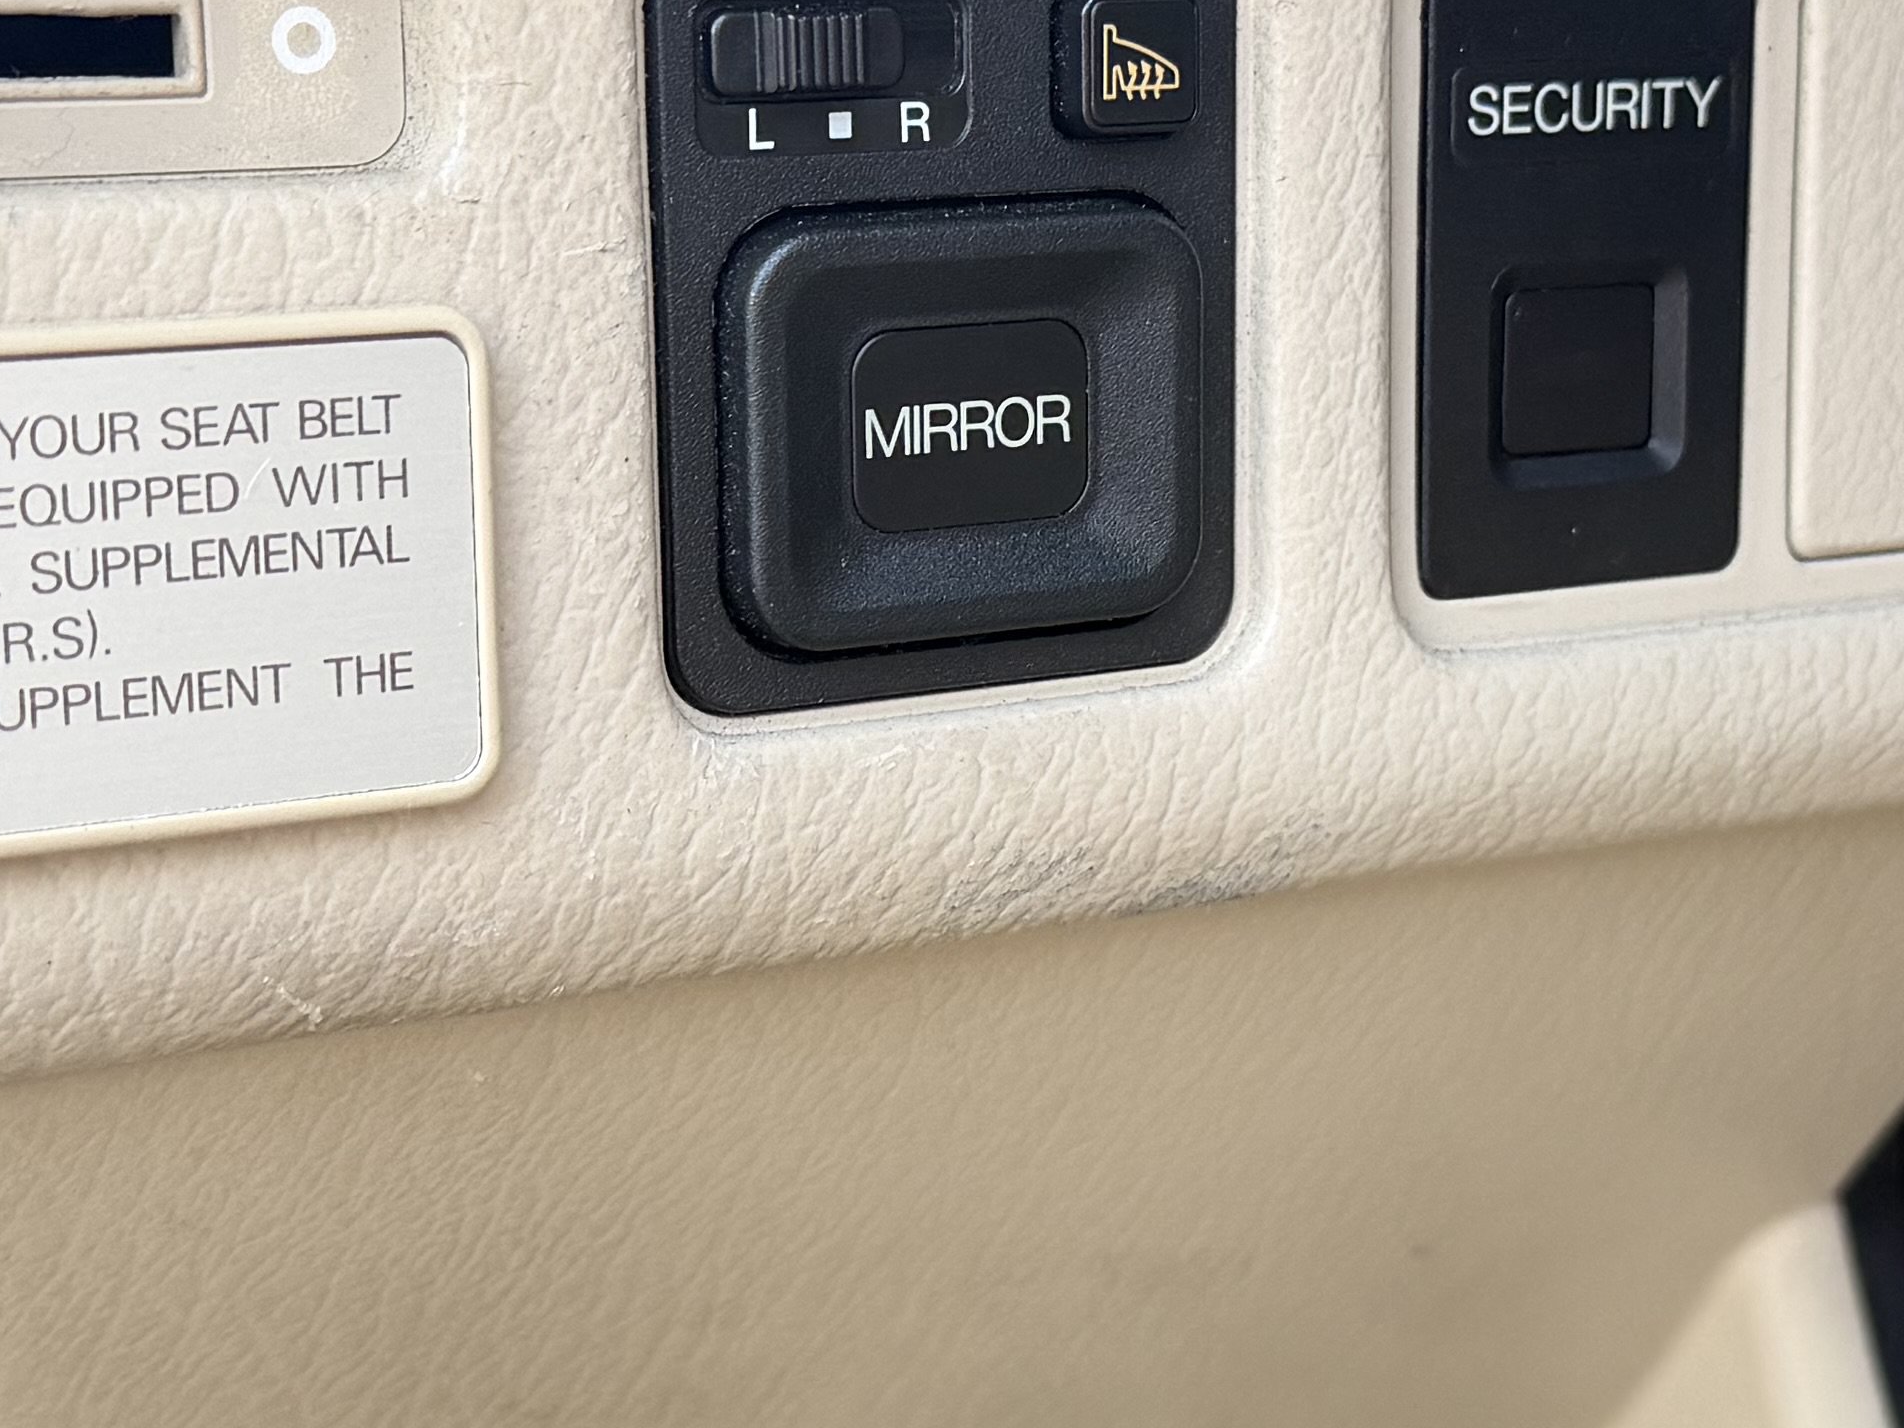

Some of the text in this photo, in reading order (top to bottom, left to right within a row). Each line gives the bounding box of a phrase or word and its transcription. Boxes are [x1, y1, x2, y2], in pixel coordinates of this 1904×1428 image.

[749, 108, 774, 150] L
[900, 101, 930, 142] R
[1468, 79, 1719, 135] SECURITY
[160, 402, 280, 450] SEAT
[299, 394, 402, 440] BELT
[865, 395, 1070, 459] MIRROR
[272, 458, 408, 507] WITH
[31, 525, 410, 594] SUPPLEMENTAL
[323, 651, 414, 697] THE
